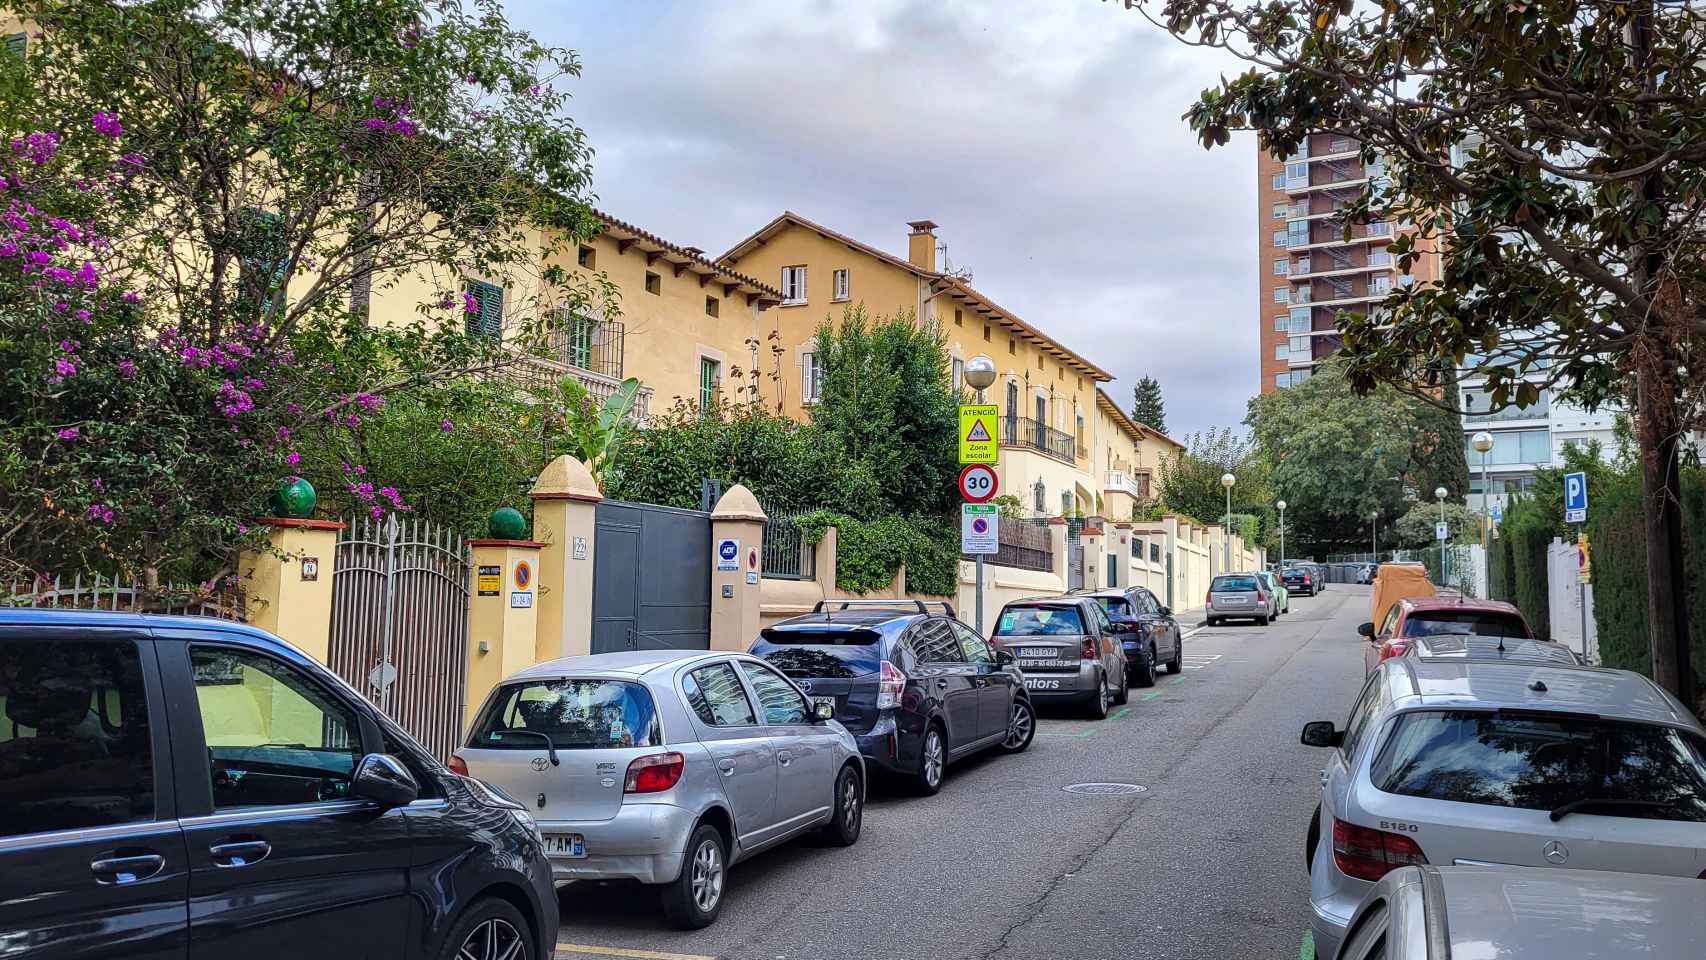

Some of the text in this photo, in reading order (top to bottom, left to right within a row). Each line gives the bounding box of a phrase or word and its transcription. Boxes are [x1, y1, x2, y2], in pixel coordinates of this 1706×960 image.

[963, 408, 996, 416] ATENCIÓ
[967, 477, 989, 489] 30
[1568, 478, 1581, 507] P
